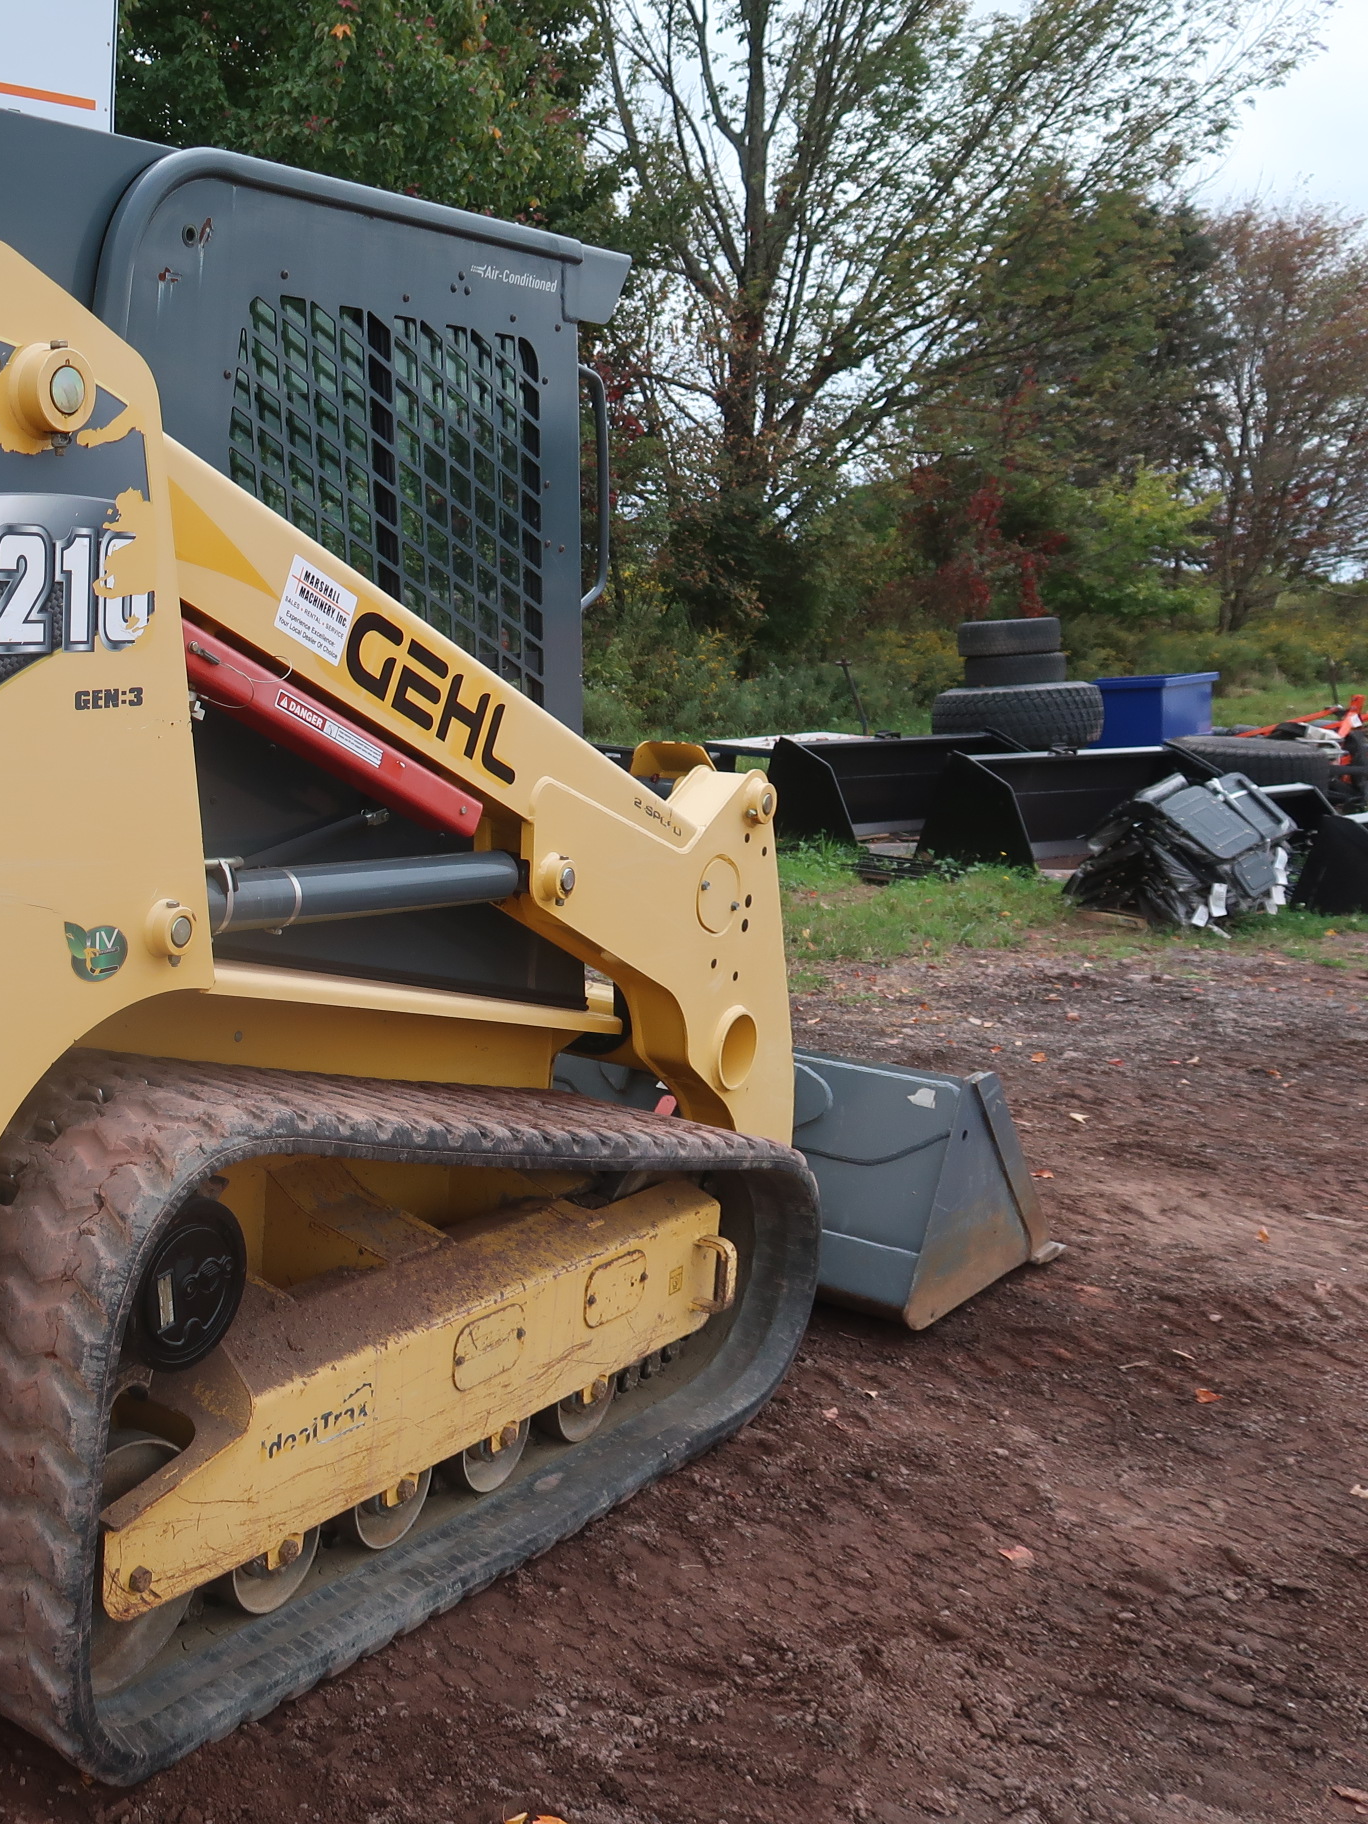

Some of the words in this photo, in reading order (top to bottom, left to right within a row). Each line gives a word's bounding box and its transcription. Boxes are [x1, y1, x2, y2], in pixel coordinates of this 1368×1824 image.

[484, 264, 558, 293] Air-Conditioned
[303, 570, 340, 604] MARSHALL
[285, 596, 300, 610] SALES
[304, 609, 321, 624] RENTAL
[326, 623, 344, 639] SERVICE
[286, 610, 311, 631] Experience
[335, 612, 348, 628] Inc.
[279, 616, 289, 627] Your
[289, 624, 302, 635] Local
[302, 632, 316, 645] Dealer
[323, 646, 338, 660] Choice
[75, 687, 144, 710] GEN:3
[346, 612, 516, 785] GEHL
[289, 701, 324, 728] DANGER
